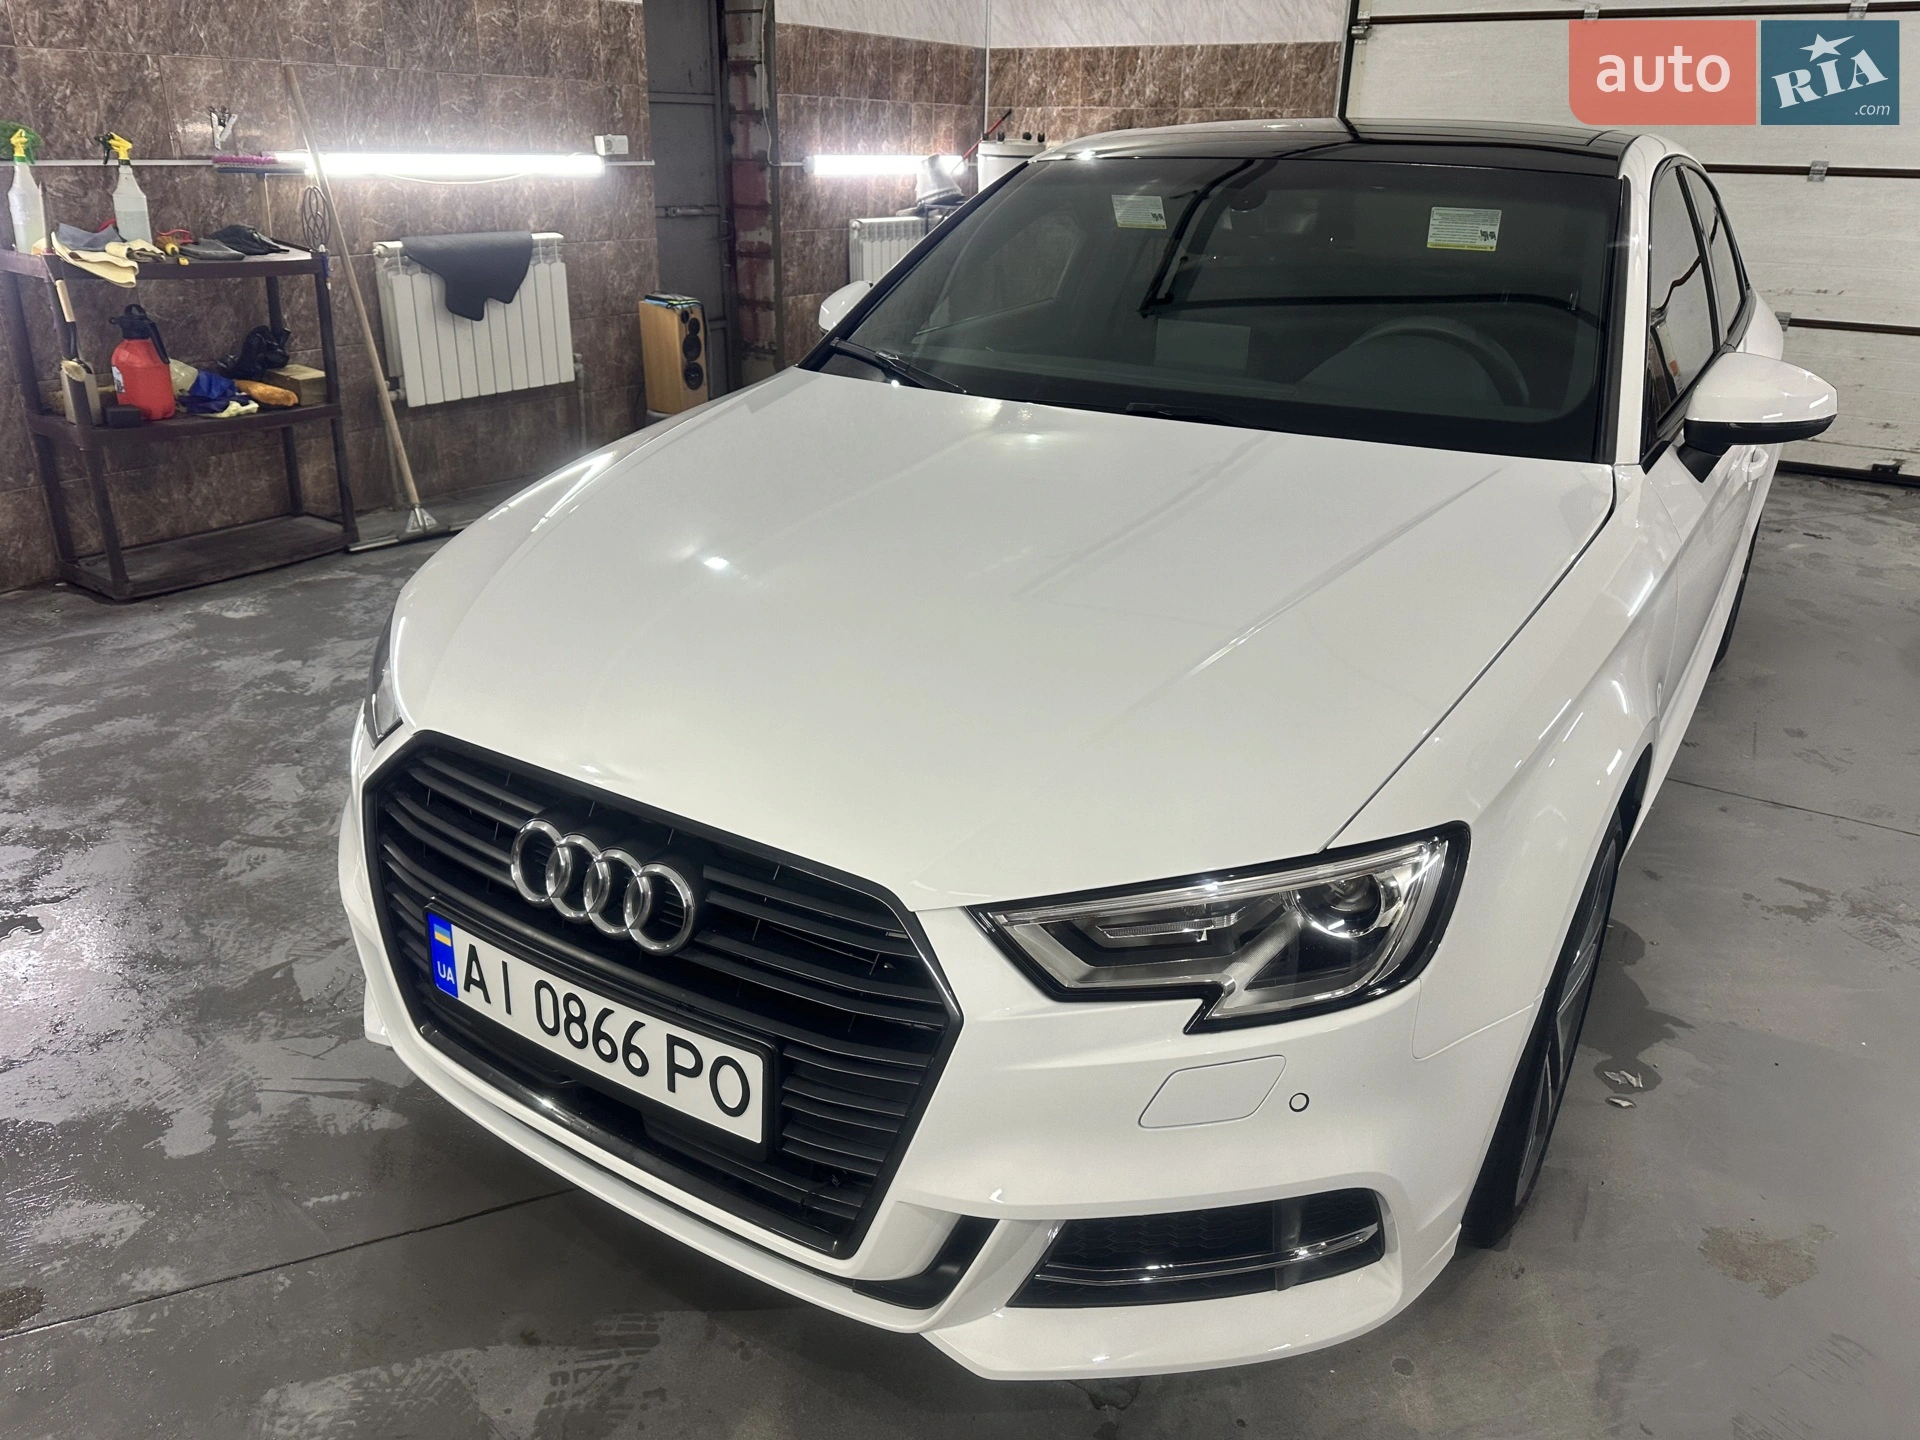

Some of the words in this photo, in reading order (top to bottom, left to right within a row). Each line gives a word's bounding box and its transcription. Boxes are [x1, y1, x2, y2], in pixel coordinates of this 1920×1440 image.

[437, 961, 455, 985] UA
[463, 943, 512, 1016] AI
[534, 979, 650, 1078] 0866
[666, 1033, 750, 1118] PO
